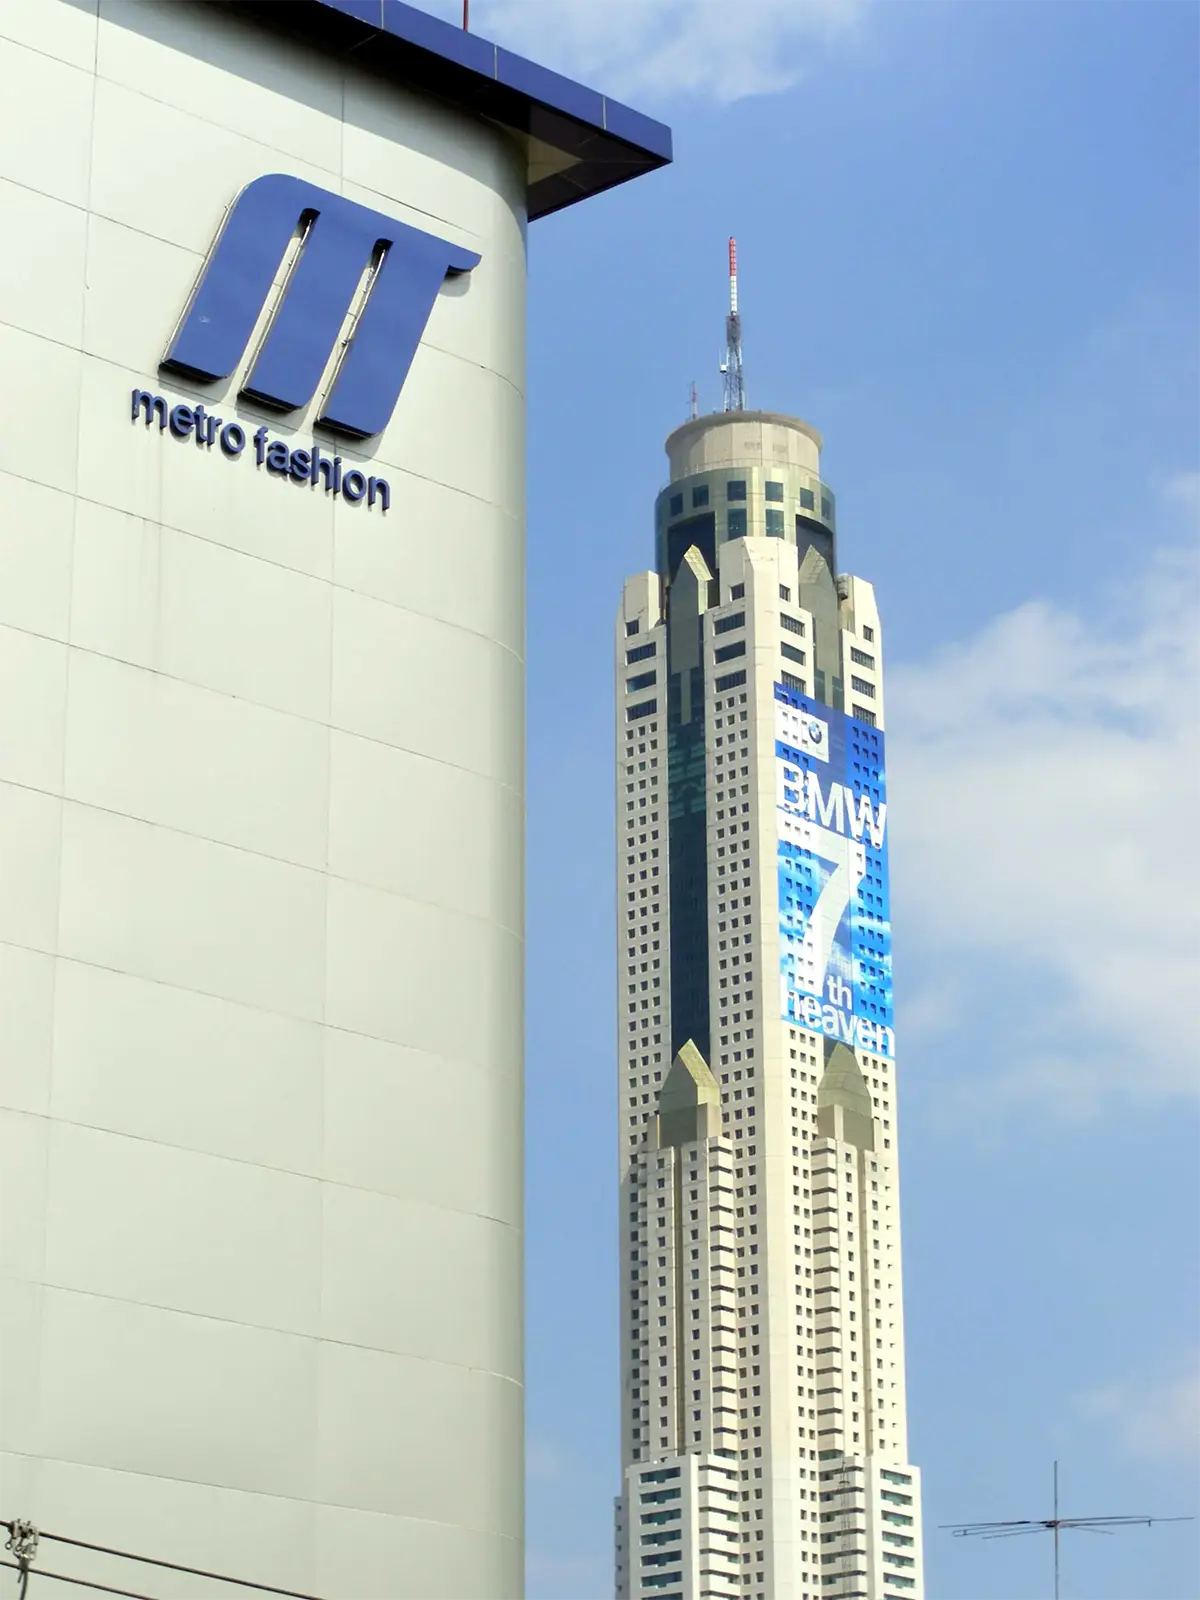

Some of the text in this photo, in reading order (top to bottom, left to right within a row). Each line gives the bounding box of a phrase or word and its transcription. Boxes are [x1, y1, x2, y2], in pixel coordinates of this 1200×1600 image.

[131, 388, 391, 511] metro fashion
[775, 756, 888, 850] BMW
[780, 975, 896, 1057] heaven
